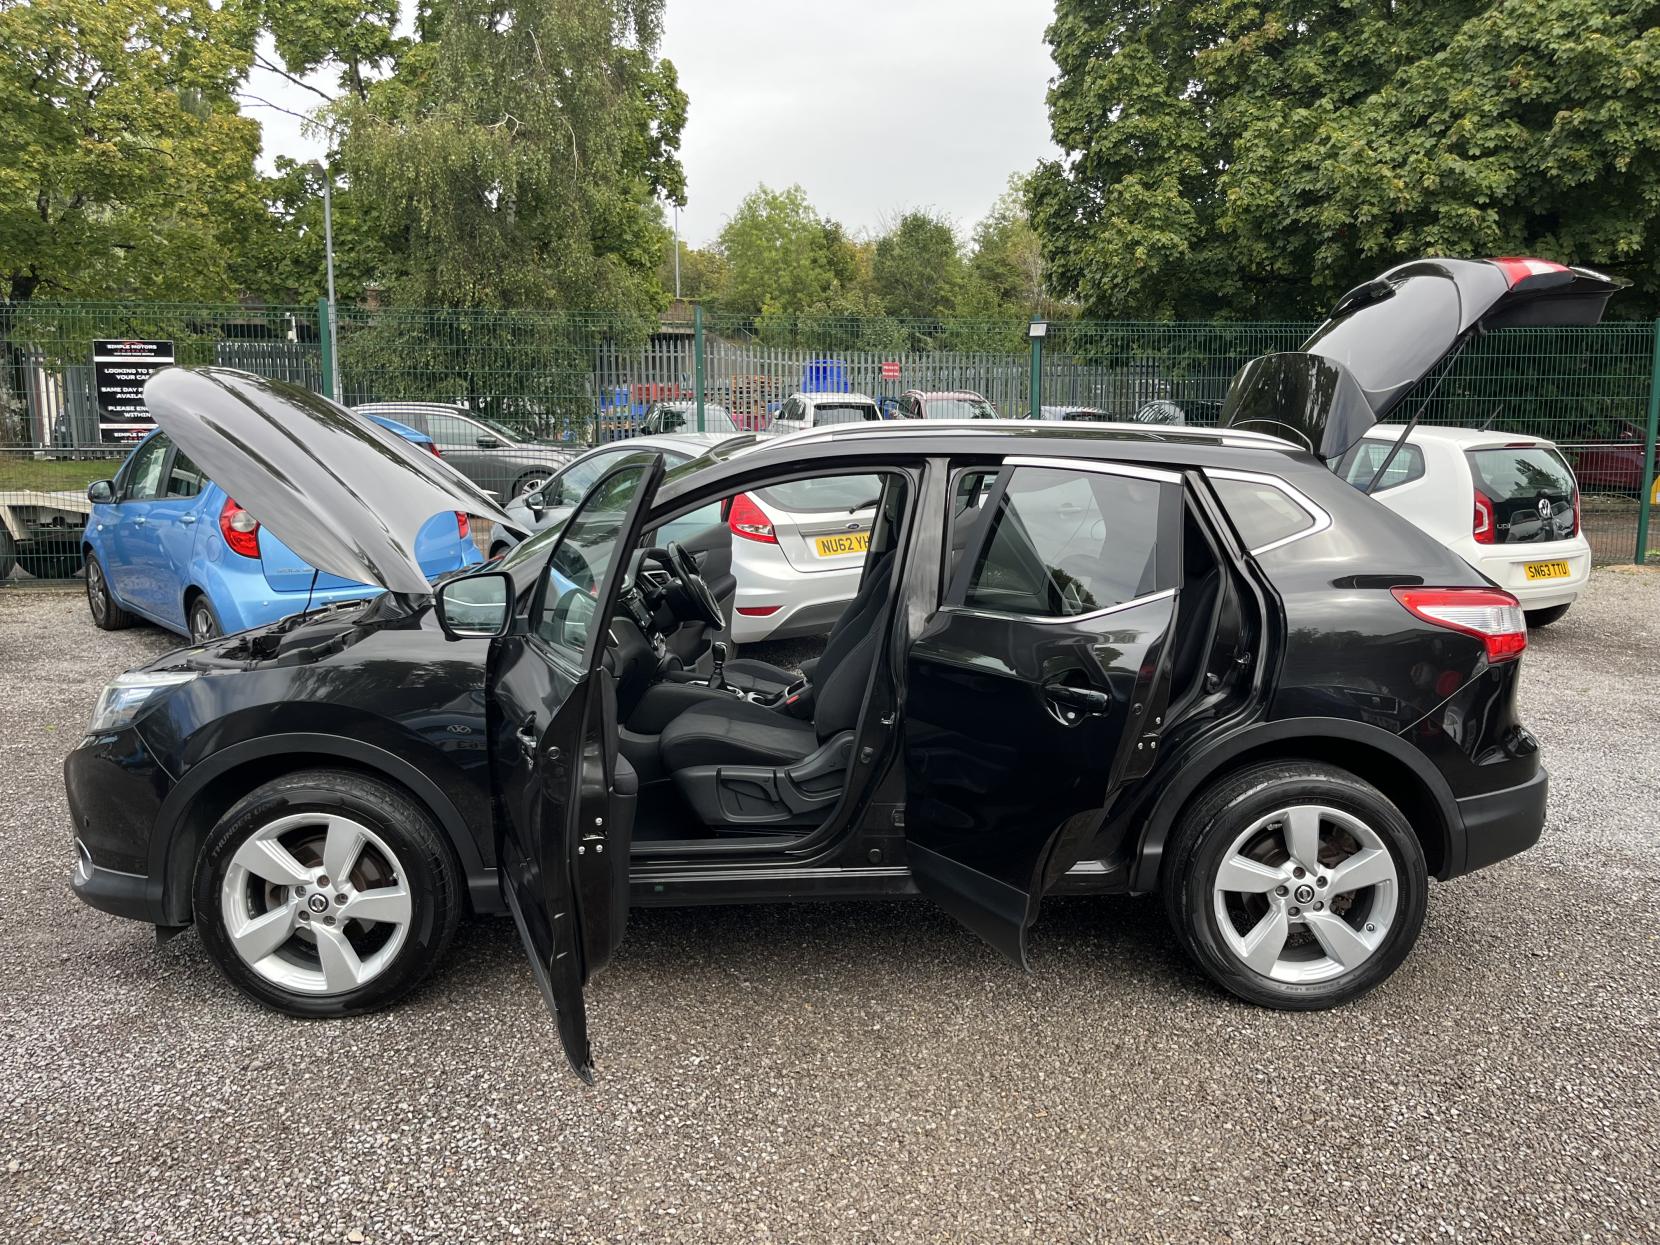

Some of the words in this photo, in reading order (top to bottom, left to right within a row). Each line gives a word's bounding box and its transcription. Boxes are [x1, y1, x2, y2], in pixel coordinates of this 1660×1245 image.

[822, 538, 855, 553] NU62
[1529, 564, 1551, 578] SN63
[1551, 563, 1567, 575] TTU
[211, 813, 252, 858] THUNDER
